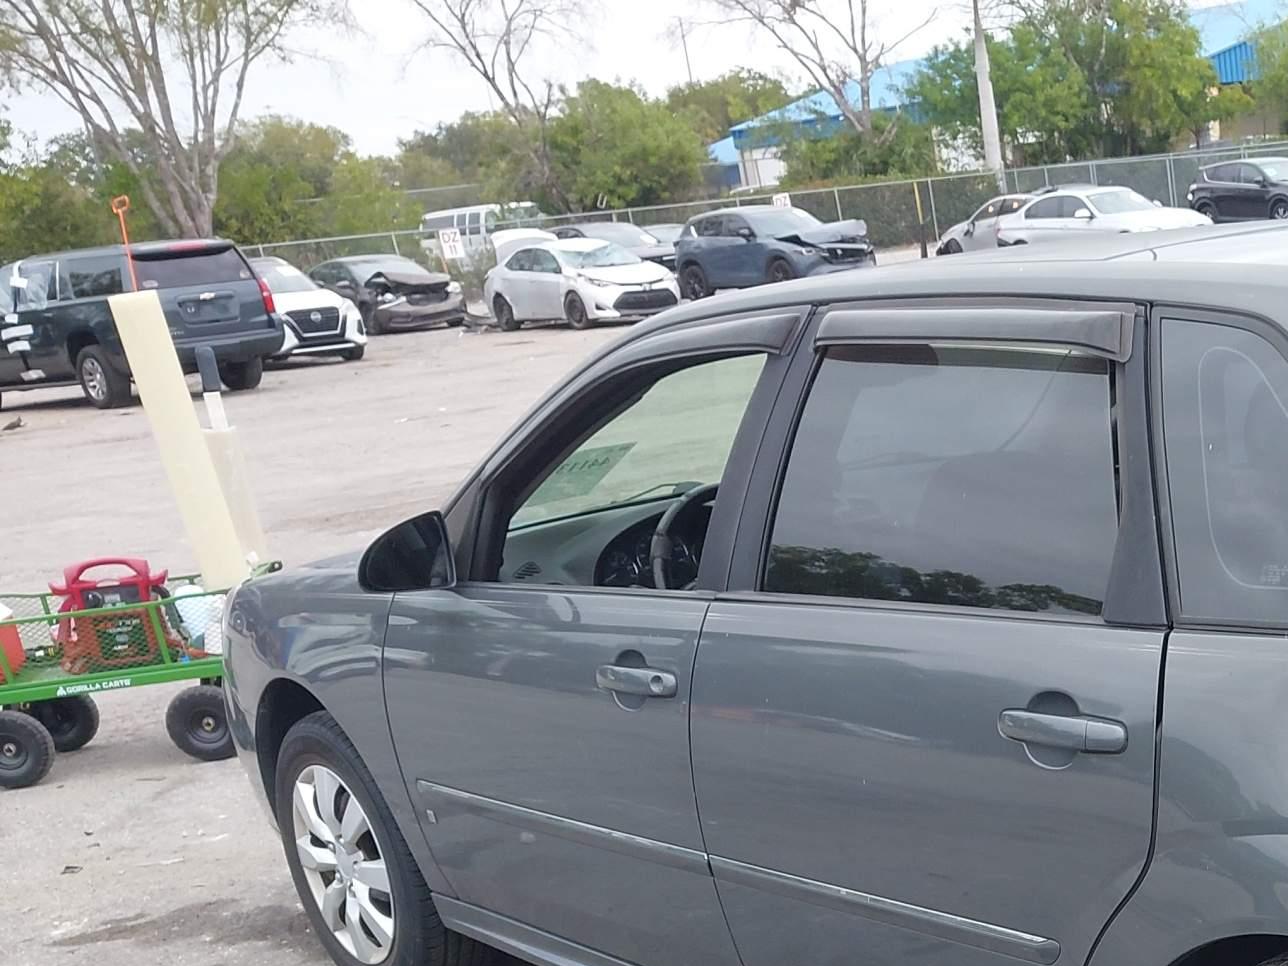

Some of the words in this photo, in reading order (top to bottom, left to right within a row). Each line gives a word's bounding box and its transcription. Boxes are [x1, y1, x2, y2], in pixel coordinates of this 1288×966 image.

[441, 231, 459, 243] DZ
[448, 244, 458, 256] 11
[66, 682, 101, 694] GORILLA
[102, 678, 131, 689] CARTS
